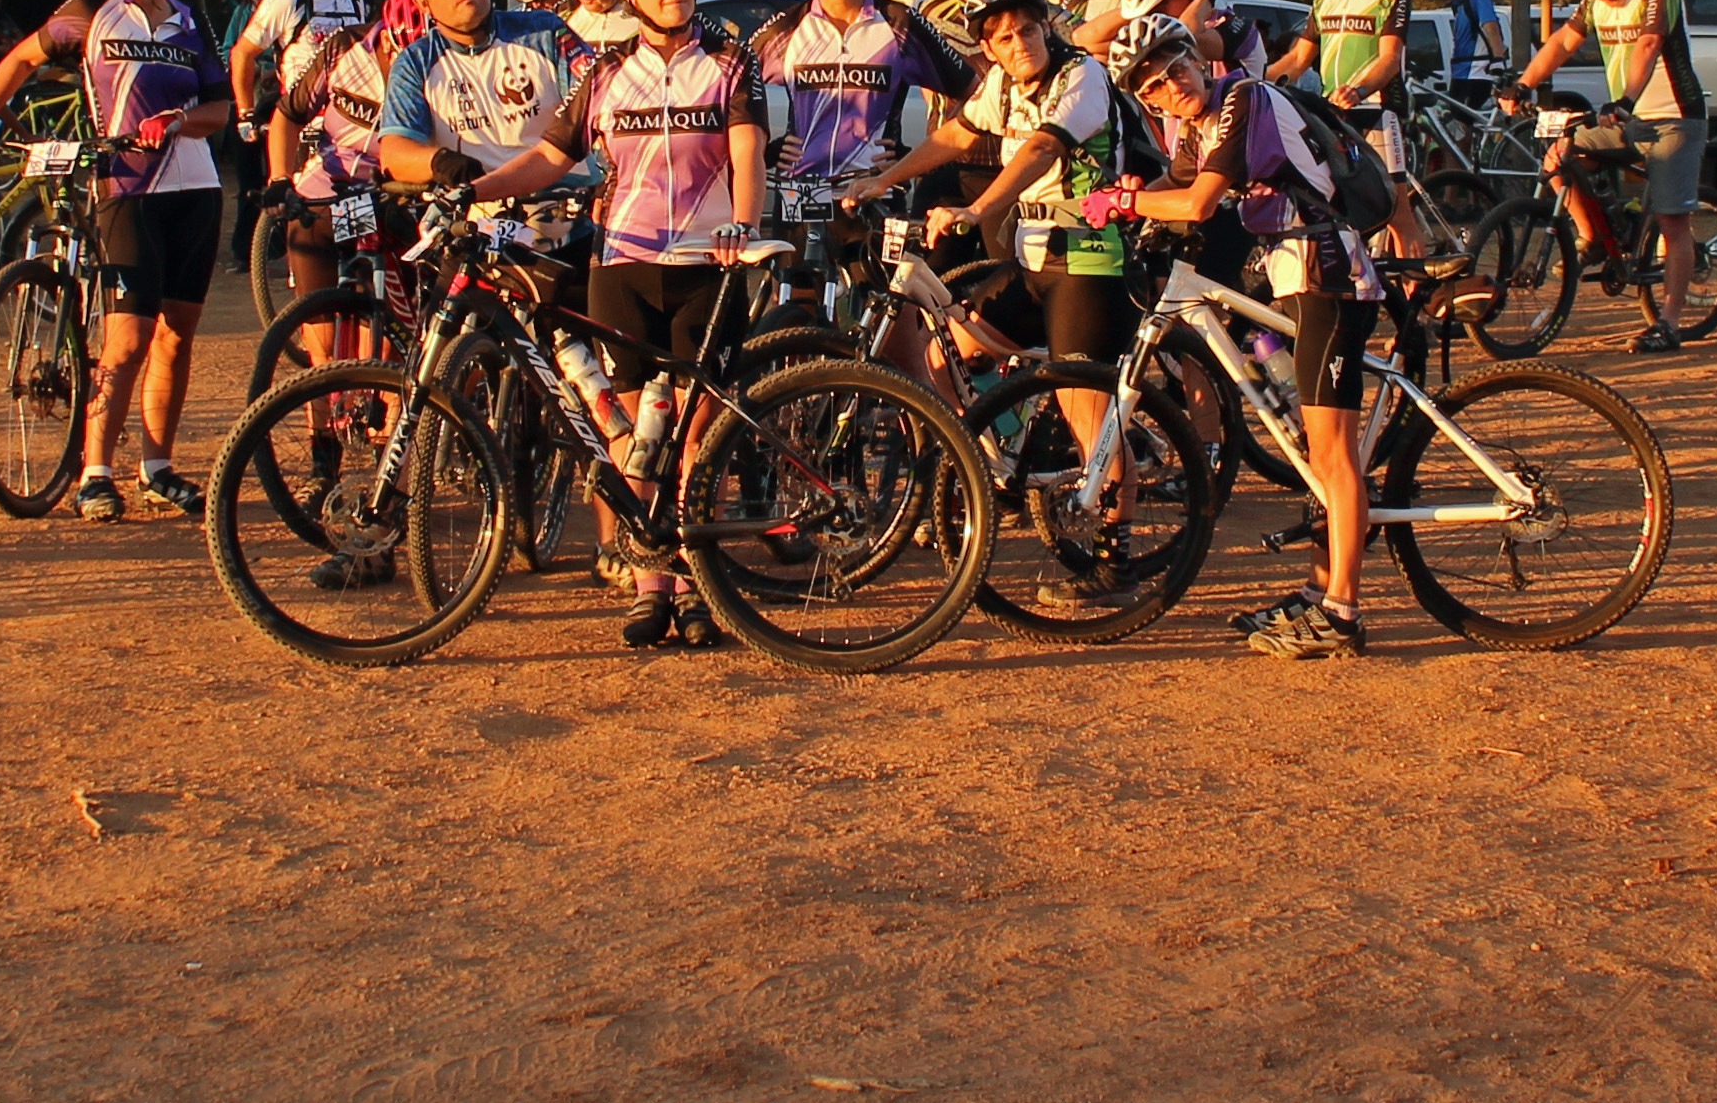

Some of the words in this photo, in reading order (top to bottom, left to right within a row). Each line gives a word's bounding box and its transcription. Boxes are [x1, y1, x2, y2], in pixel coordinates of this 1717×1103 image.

[905, 6, 964, 71] NAMAQUA
[451, 77, 473, 95] Ride
[796, 68, 887, 86] NAMAQUA
[459, 99, 476, 112] for
[504, 106, 540, 124] WWF
[617, 110, 719, 132] NAMAQUA
[449, 116, 491, 133] Nature
[46, 143, 61, 158] 40
[497, 220, 516, 240] 52
[515, 338, 612, 465] MERIDA
